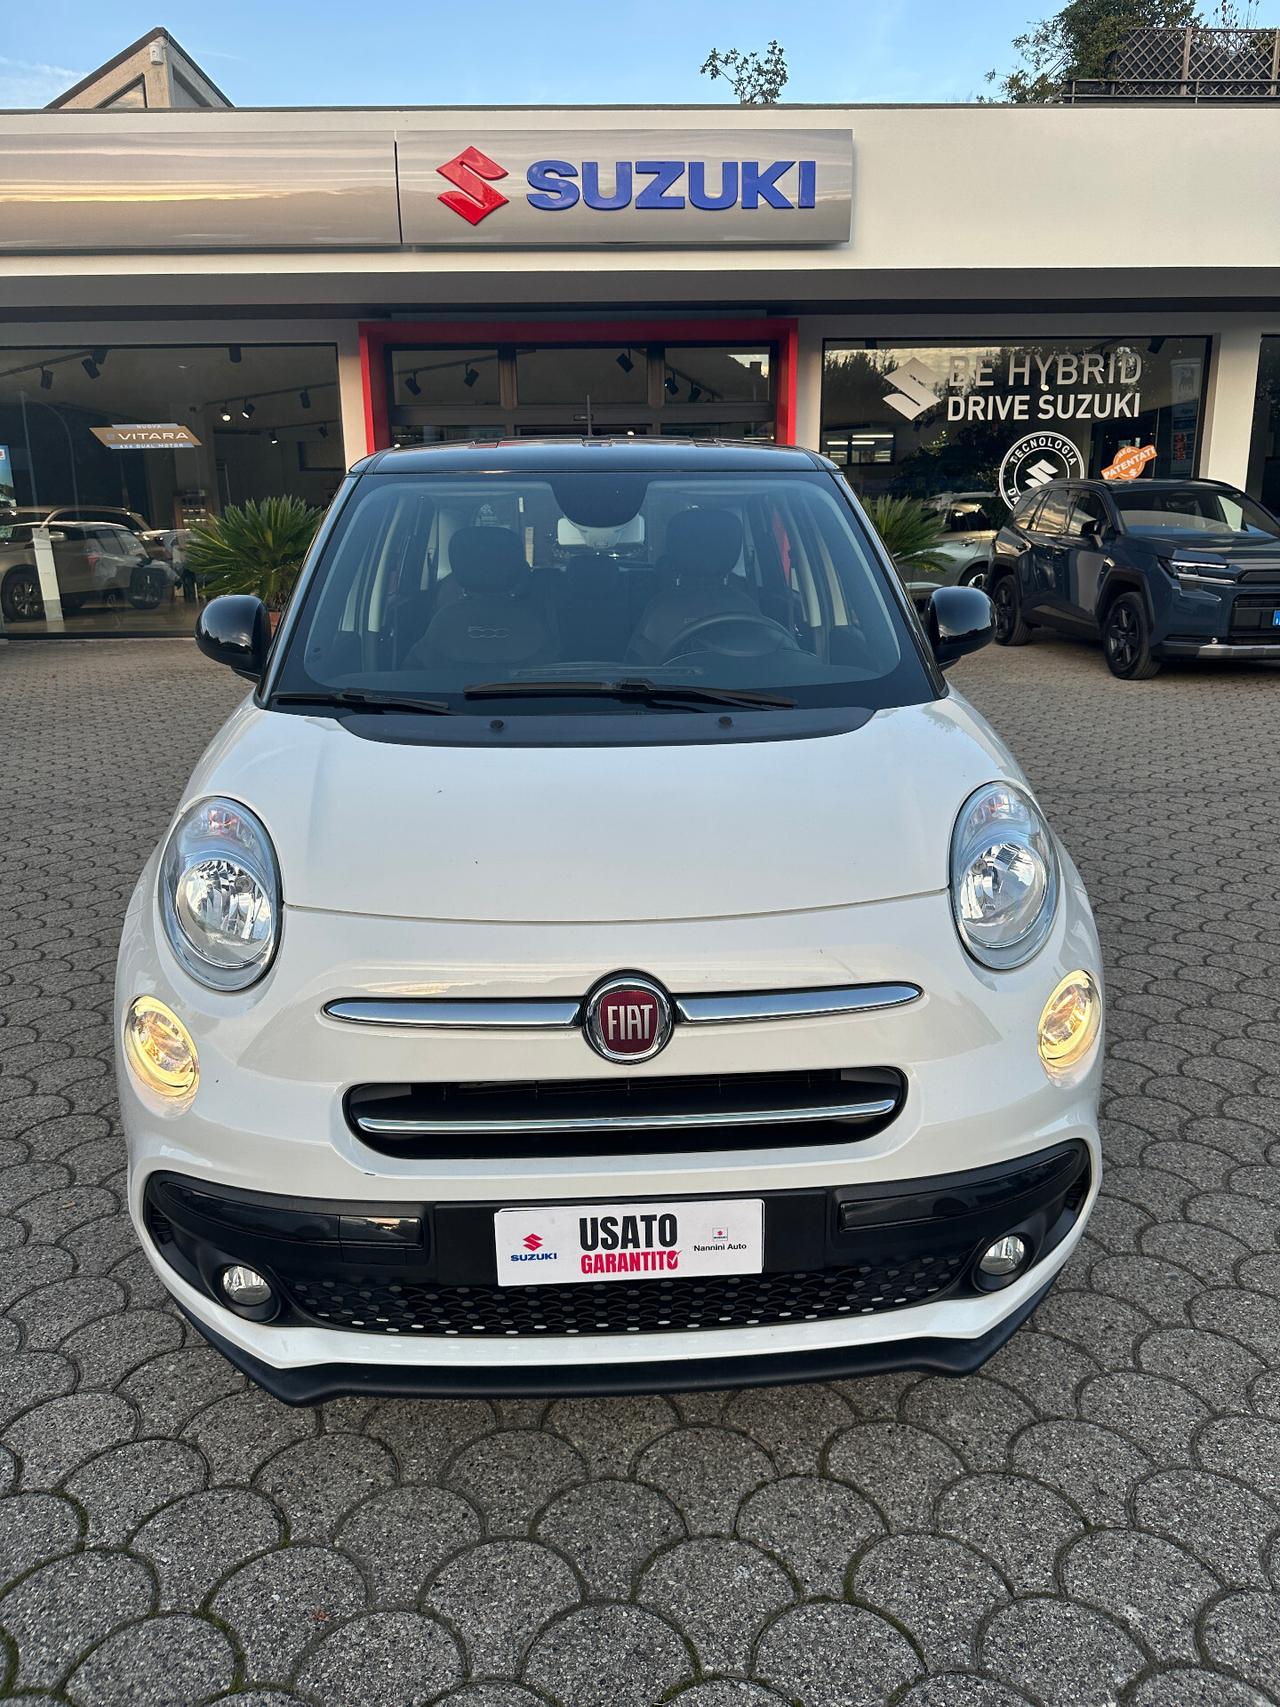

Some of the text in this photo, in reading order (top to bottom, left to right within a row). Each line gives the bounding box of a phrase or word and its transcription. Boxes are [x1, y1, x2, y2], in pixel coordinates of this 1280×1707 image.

[526, 160, 816, 211] SUZUKI
[949, 352, 1142, 387] BE HYBRID
[947, 393, 1141, 421] DRIVE SUZUKI
[118, 432, 189, 440] VITARA
[1009, 437, 1078, 466] TECNOLOGIA
[607, 1004, 653, 1040] FIAT
[579, 1213, 678, 1252] USATO
[510, 1252, 558, 1262] SUZUKI
[693, 1243, 725, 1252] Nannini
[581, 1250, 681, 1275] GARANTITO
